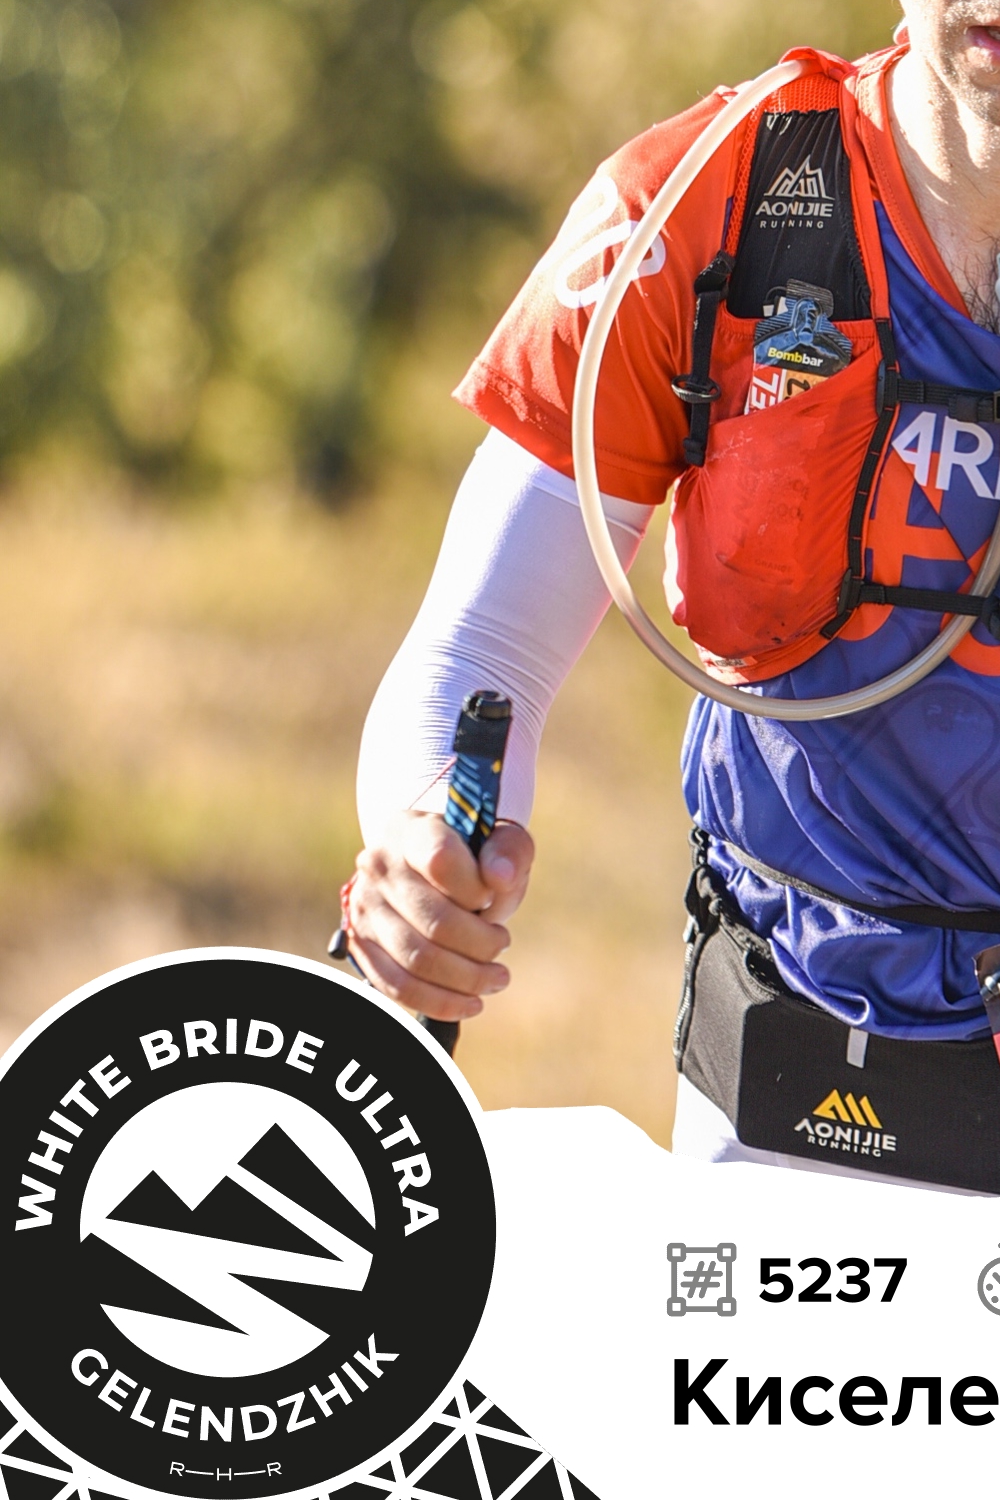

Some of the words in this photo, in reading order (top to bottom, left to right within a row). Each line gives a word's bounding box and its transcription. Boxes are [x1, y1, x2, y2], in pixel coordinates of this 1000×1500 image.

[755, 200, 834, 217] AONIJIE
[767, 346, 824, 367] Bombbar
[794, 1117, 897, 1152] AONIJIE
[807, 1135, 882, 1158] RUNNING
